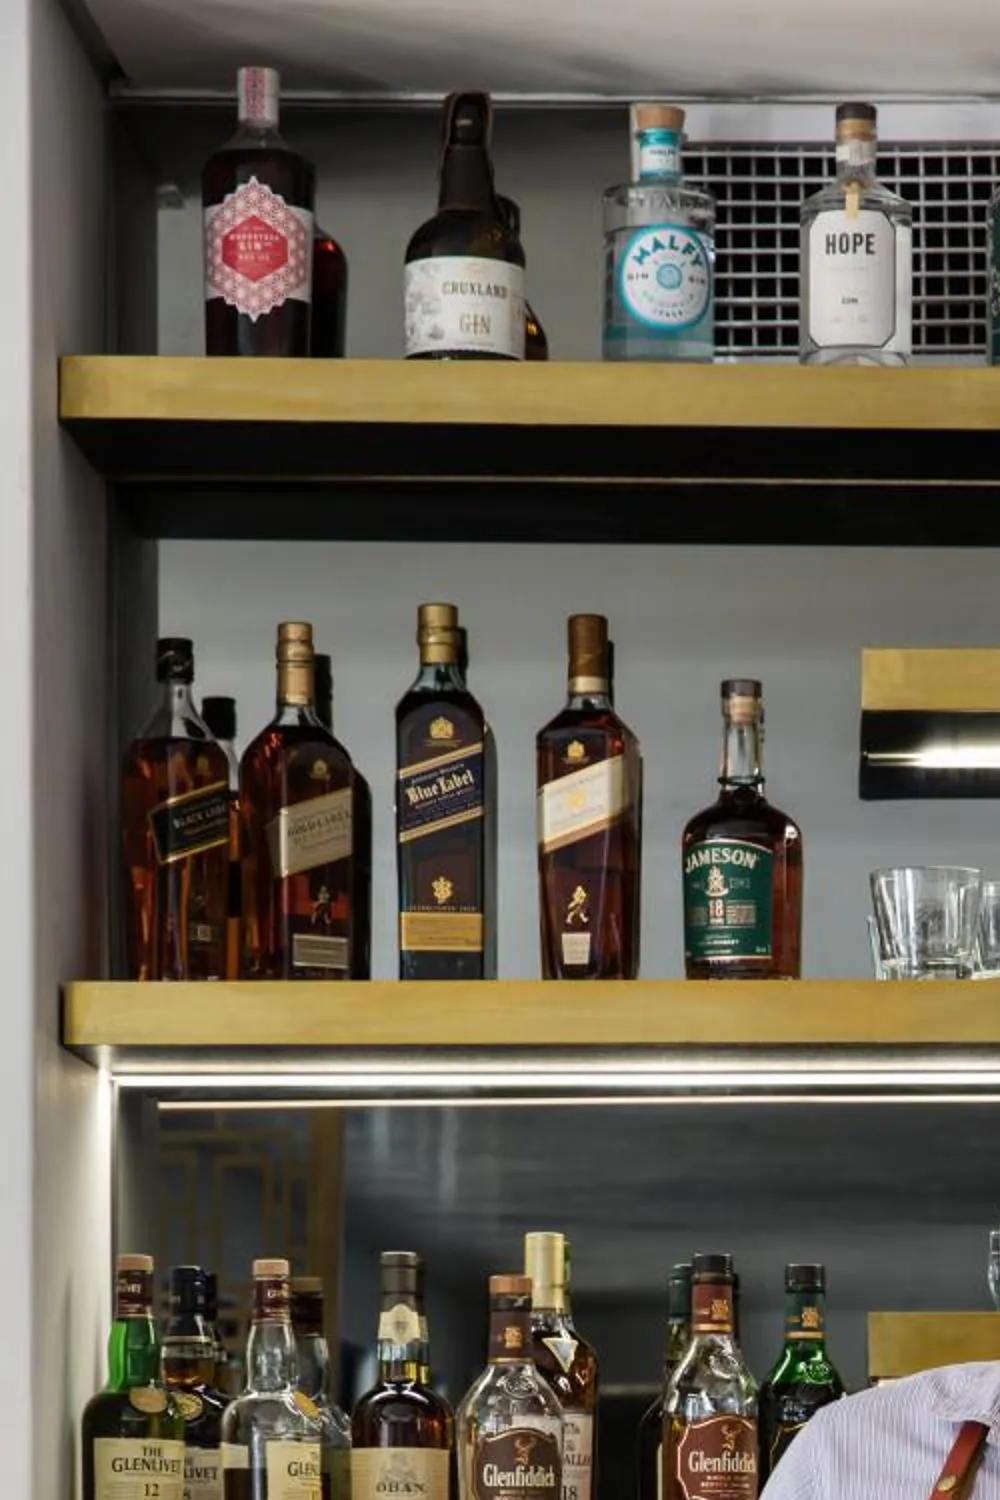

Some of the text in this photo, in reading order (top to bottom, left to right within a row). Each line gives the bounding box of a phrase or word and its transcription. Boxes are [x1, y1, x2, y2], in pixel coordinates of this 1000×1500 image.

[632, 234, 703, 265] MALFY
[825, 232, 876, 255] HOPE
[459, 314, 490, 335] GIN
[406, 783, 438, 806] Blue
[436, 769, 474, 795] Label
[685, 848, 757, 874] JAMESON
[709, 899, 724, 917] 18
[142, 1447, 162, 1457] THE
[183, 1467, 218, 1481] LIVET
[144, 1483, 160, 1497] 12
[376, 1481, 427, 1494] OBAN
[562, 1486, 578, 1500] 18
